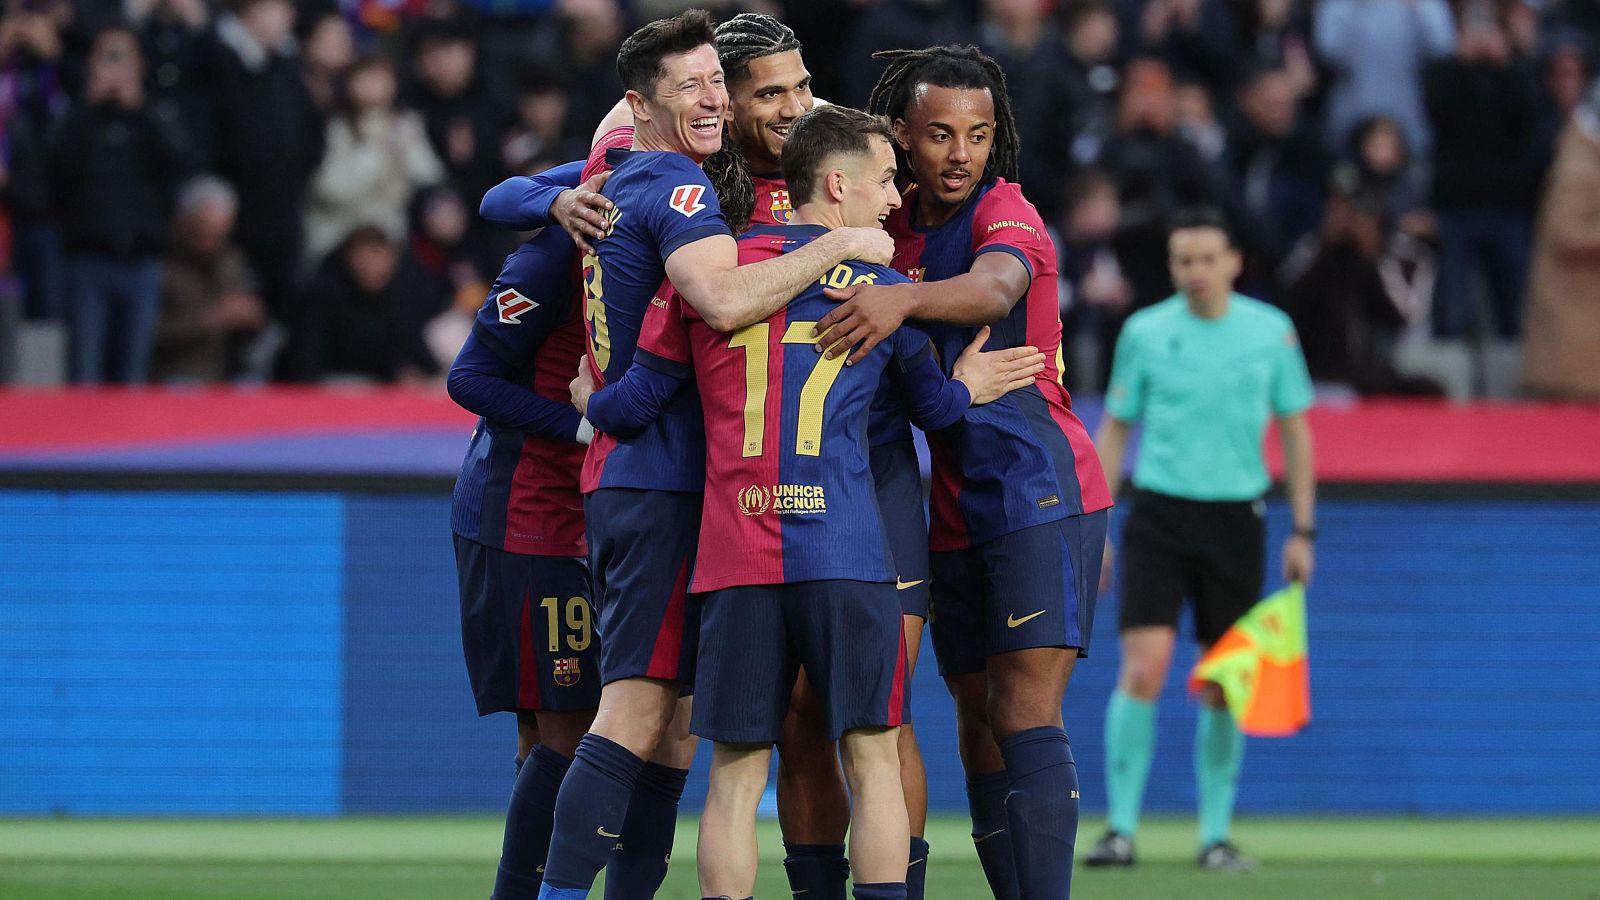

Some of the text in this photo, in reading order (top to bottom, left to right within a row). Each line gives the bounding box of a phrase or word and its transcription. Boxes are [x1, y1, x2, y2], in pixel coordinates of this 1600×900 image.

[987, 220, 1037, 236] AMBILIGHT
[728, 321, 851, 457] 17
[772, 485, 825, 497] UNHCR
[772, 497, 826, 509] ACNUR
[540, 596, 592, 652] 19
